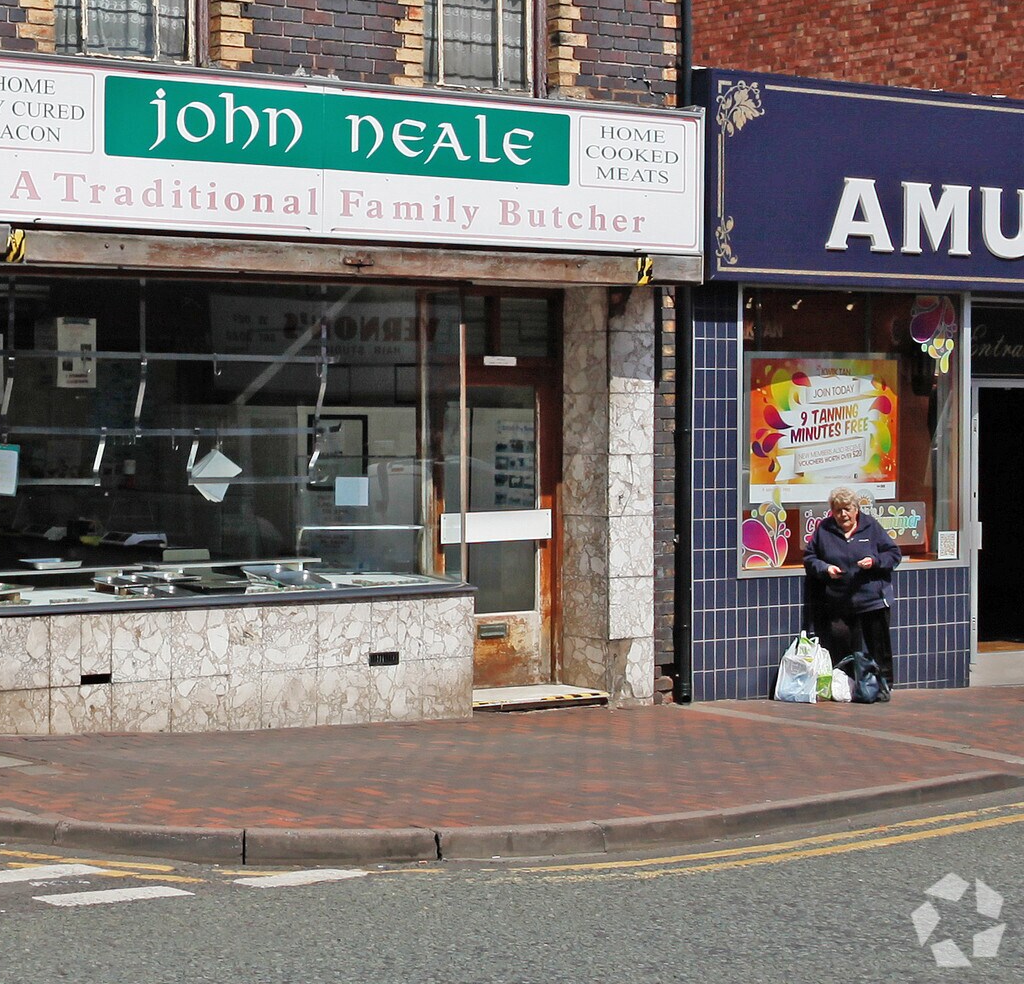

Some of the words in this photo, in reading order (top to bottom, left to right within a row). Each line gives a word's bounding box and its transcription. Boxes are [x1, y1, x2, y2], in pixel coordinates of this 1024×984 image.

[12, 101, 85, 121] CURED
[600, 125, 666, 144] HOME
[586, 144, 679, 165] COOKED
[596, 166, 669, 185] MEATS
[10, 170, 41, 201] A
[53, 172, 319, 216] Traditional
[340, 189, 480, 230] Family
[498, 199, 646, 233] Butcher
[825, 176, 1024, 260] AMU
[813, 387, 831, 398] JOIN
[832, 384, 855, 396] TODAY
[800, 411, 808, 426] 9
[811, 404, 859, 424] TANNING
[790, 422, 841, 444] MINUTES
[845, 417, 869, 435] FREE
